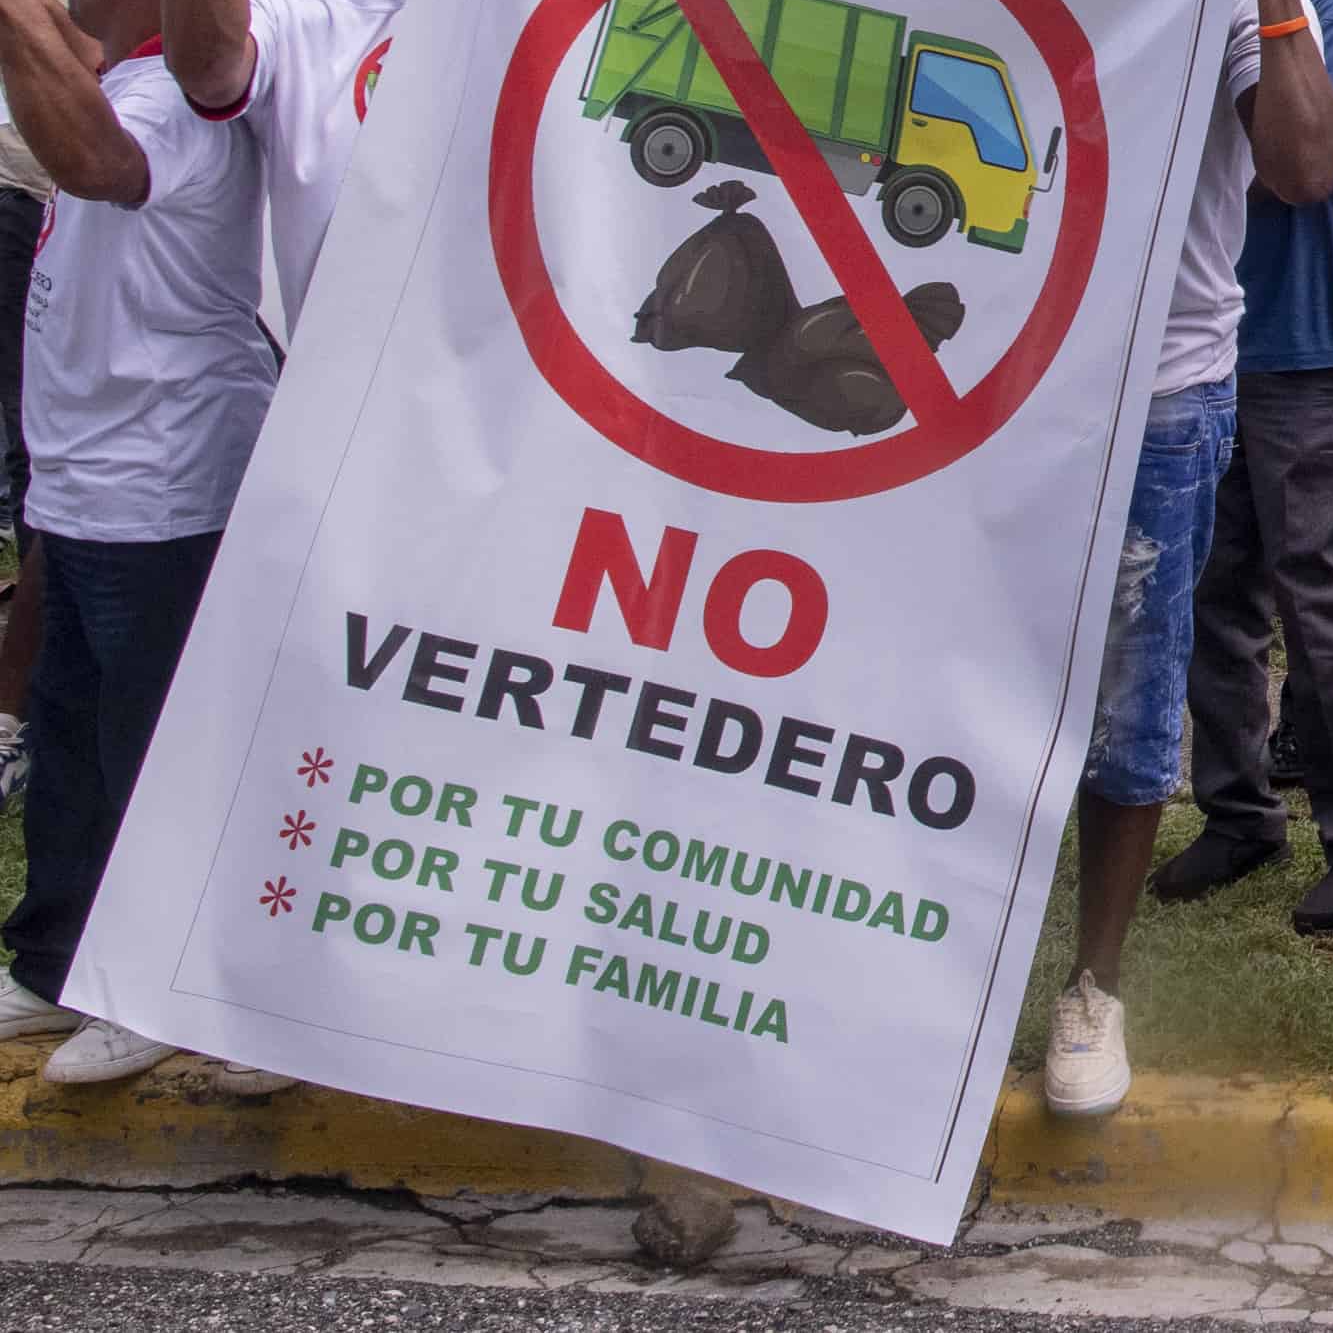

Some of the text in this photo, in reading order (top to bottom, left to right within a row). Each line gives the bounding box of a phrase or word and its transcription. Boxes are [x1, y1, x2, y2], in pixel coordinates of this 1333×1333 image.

[551, 506, 828, 677] NO
[344, 610, 976, 831] VERTEDERO
[329, 827, 770, 966] POR TU SALUD
[347, 762, 951, 943] POR TU COMUNIDAD
[311, 891, 790, 1043] POR TU FAMILIA
